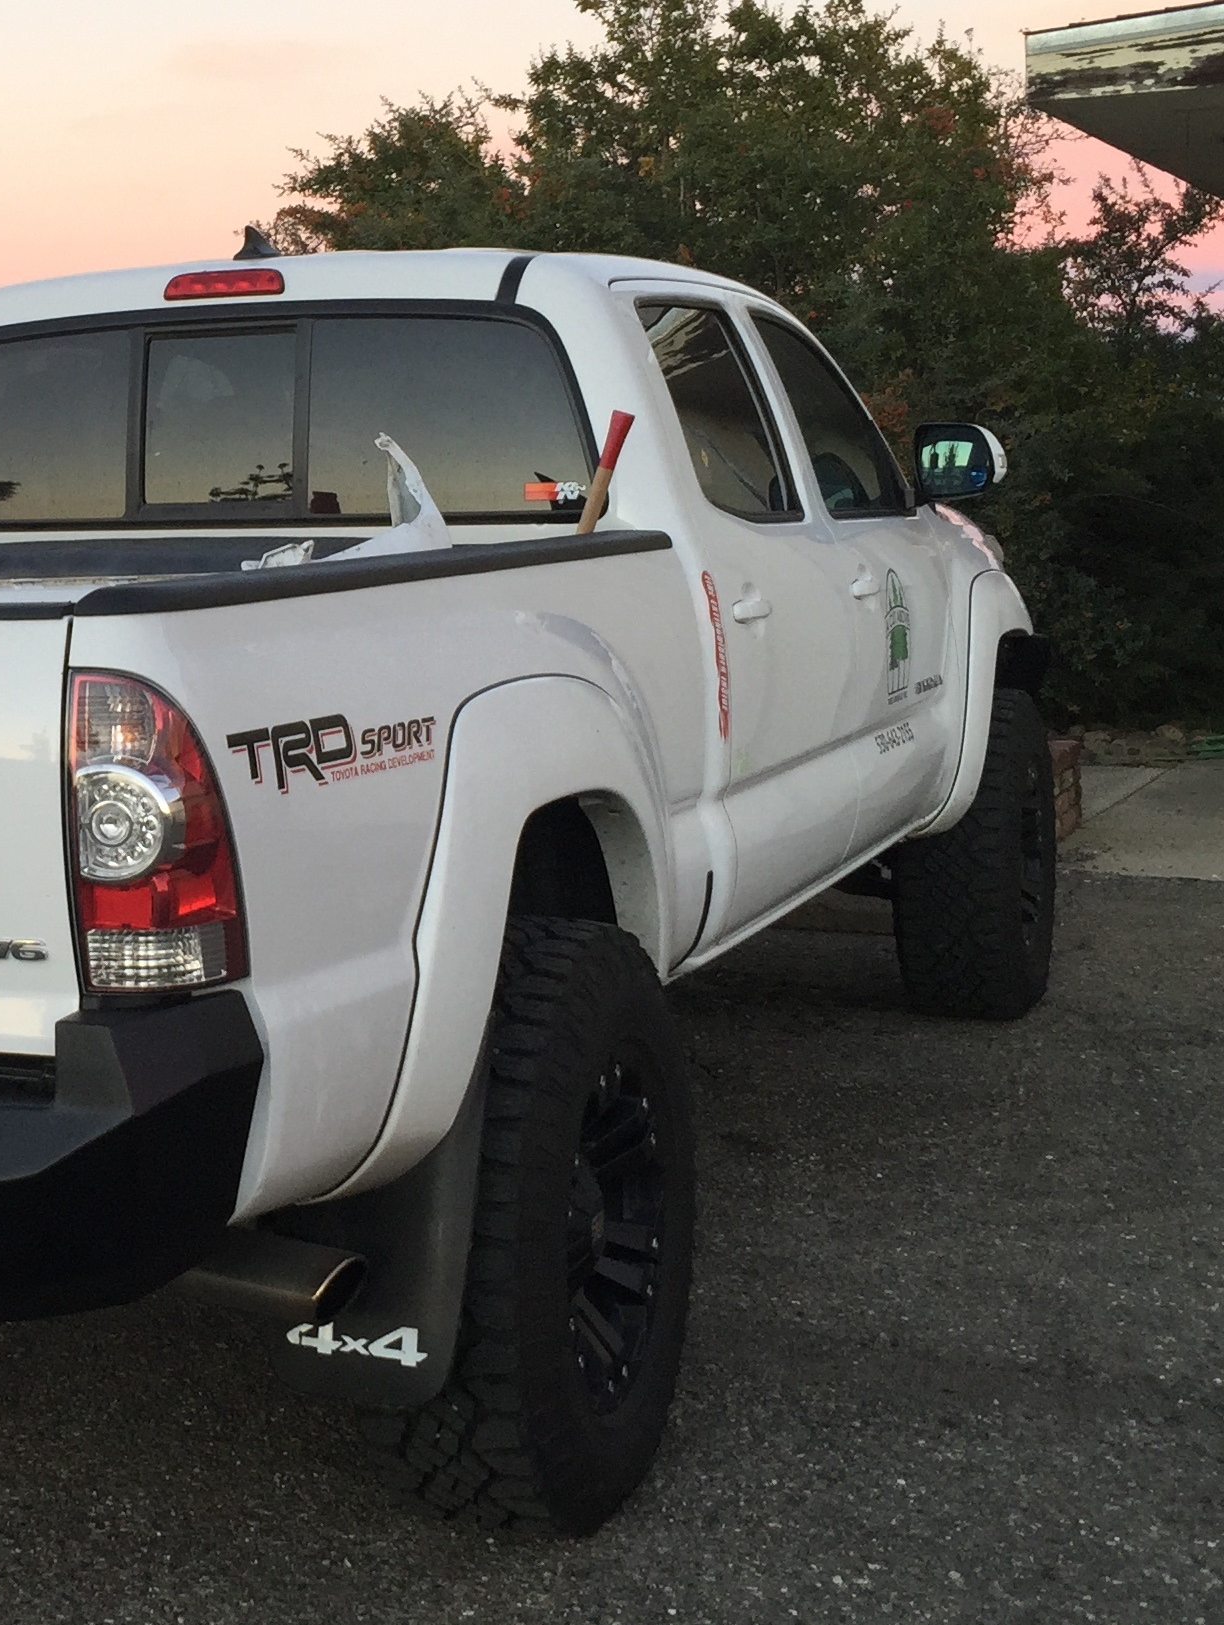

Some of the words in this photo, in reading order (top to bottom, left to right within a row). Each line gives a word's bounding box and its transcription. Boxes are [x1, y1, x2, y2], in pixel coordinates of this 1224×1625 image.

[226, 714, 357, 794] TRD
[360, 716, 436, 758] SPORT
[331, 766, 358, 781] TOYOTA
[360, 760, 387, 775] RACING
[388, 750, 435, 769] DEVELOPMENT
[286, 1321, 428, 1368] 4x4
